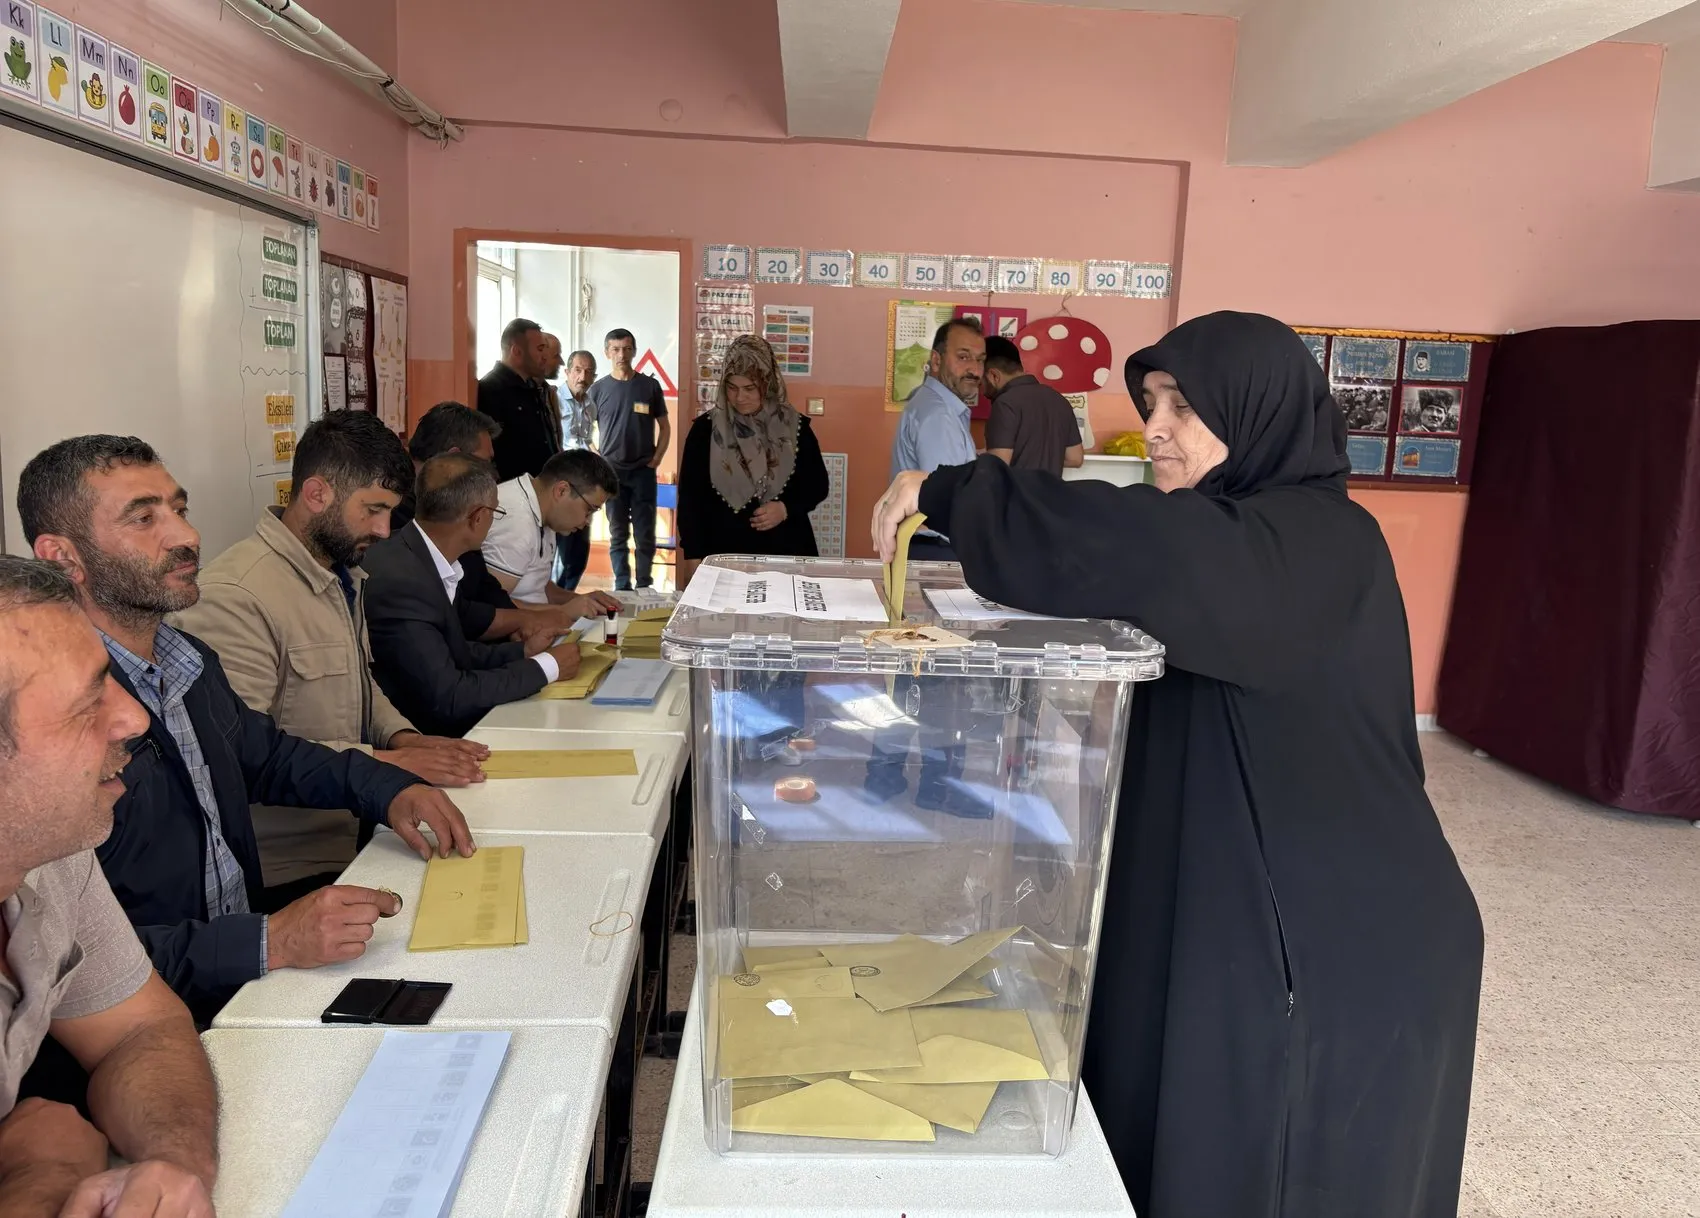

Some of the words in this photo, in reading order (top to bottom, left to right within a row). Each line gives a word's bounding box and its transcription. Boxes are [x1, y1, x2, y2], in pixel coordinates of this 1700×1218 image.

[9, 2, 25, 29] Kk
[50, 22, 63, 47] Ll
[82, 38, 104, 66] Mm
[118, 56, 134, 80] Nn
[150, 74, 165, 96] Oo
[206, 101, 215, 123] Pp
[230, 113, 239, 131] Rr
[264, 240, 296, 260] TOPLANAN
[718, 257, 738, 272] 10
[767, 260, 788, 274] 20
[819, 263, 839, 277] 30
[868, 264, 889, 279] 40
[915, 266, 936, 281] 50
[961, 268, 981, 282] 60
[1006, 270, 1026, 284] 70
[1050, 271, 1071, 286] 80
[1096, 273, 1116, 287] 90
[264, 278, 296, 296] TOPLANAN
[1135, 274, 1165, 289] 100
[266, 323, 294, 340] TOPLAM
[268, 402, 294, 417] Eksilen
